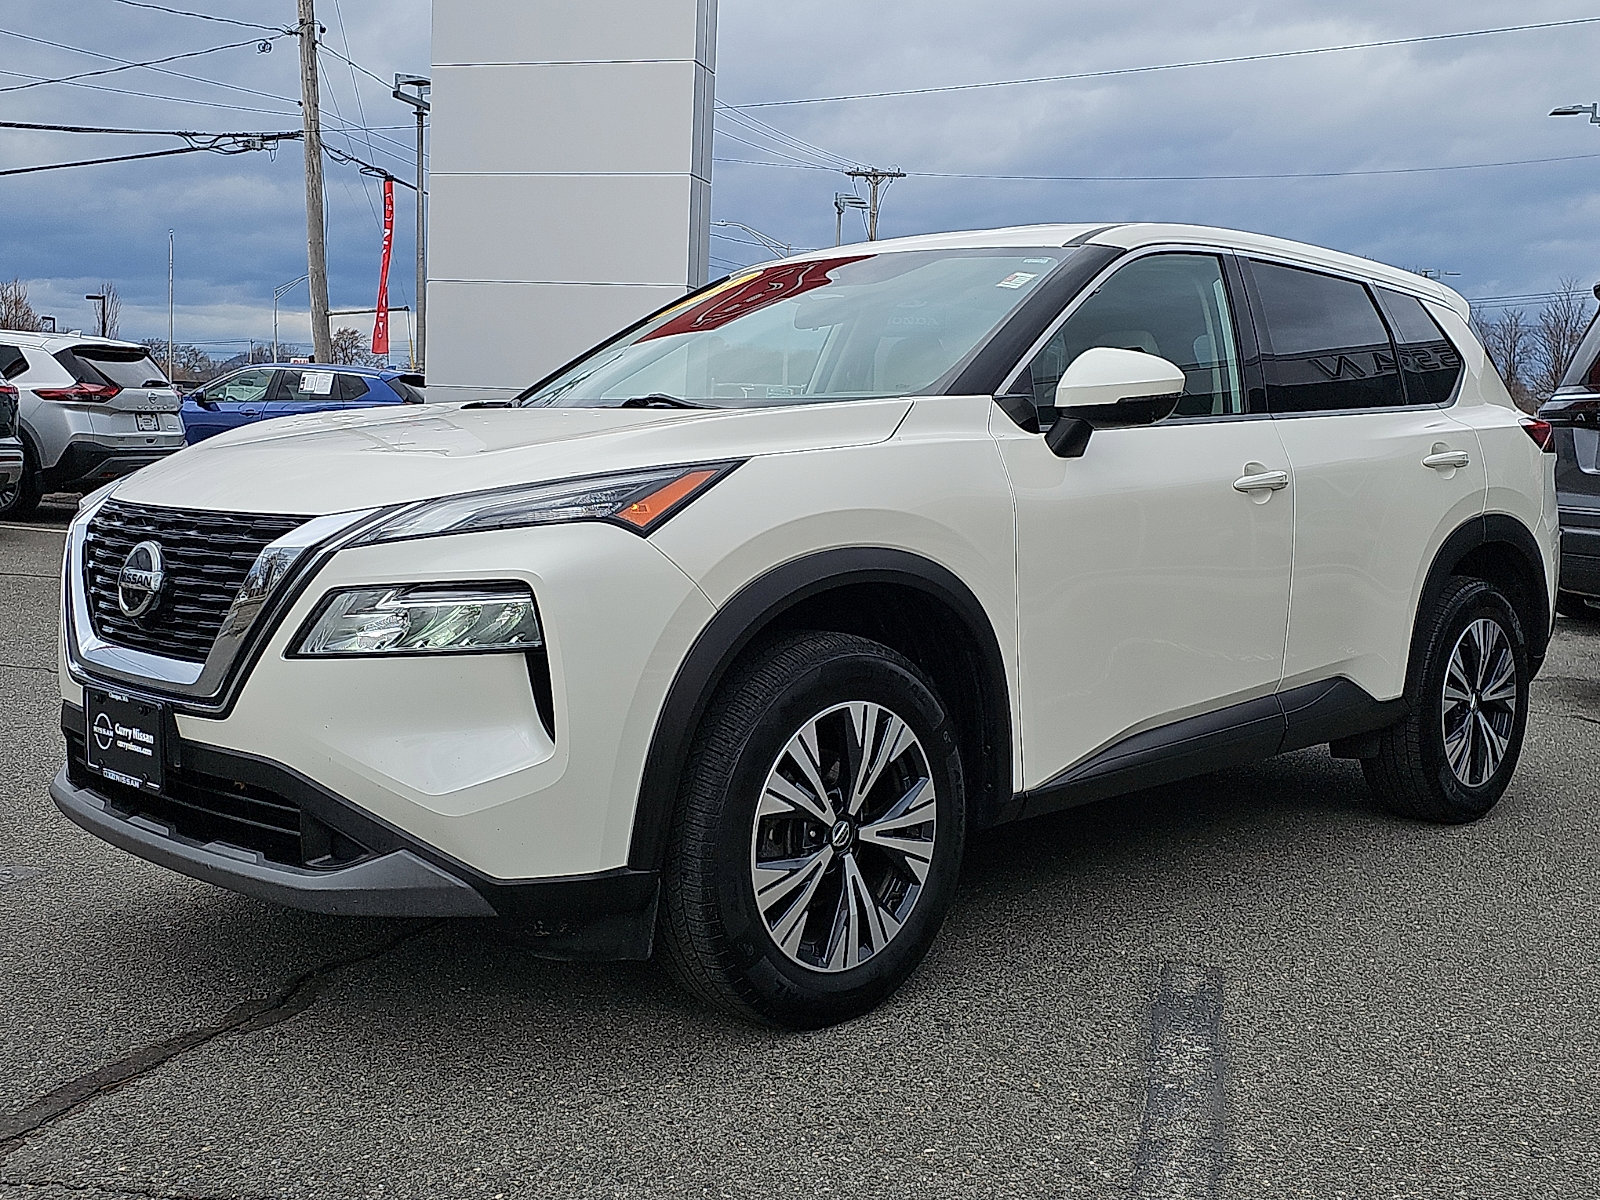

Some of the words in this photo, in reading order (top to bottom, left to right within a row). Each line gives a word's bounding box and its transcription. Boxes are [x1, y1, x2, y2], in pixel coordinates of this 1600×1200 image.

[93, 726, 114, 737] NISSAN
[114, 722, 132, 740] Curry
[132, 728, 154, 744] Nissan
